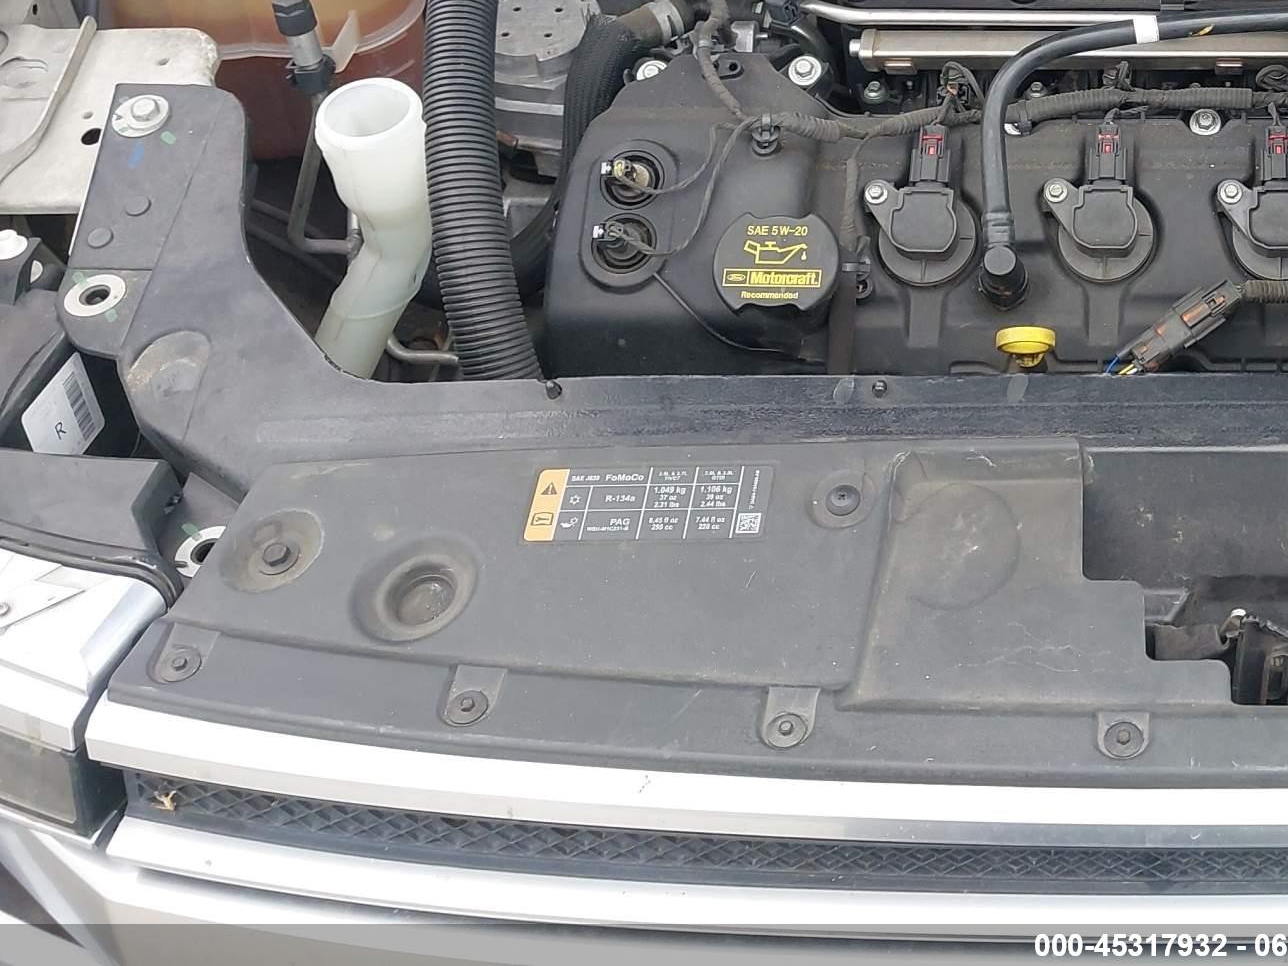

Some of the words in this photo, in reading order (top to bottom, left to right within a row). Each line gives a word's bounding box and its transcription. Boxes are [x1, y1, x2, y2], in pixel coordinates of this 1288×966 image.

[747, 226, 769, 236] SAE
[740, 290, 799, 300] Recommended
[54, 421, 68, 441] R
[605, 473, 645, 482] FoMoCo
[653, 486, 675, 494] 1.049
[675, 486, 687, 495] kg
[722, 485, 733, 494] kg
[605, 494, 636, 503] R-134a
[609, 518, 631, 526] PAG
